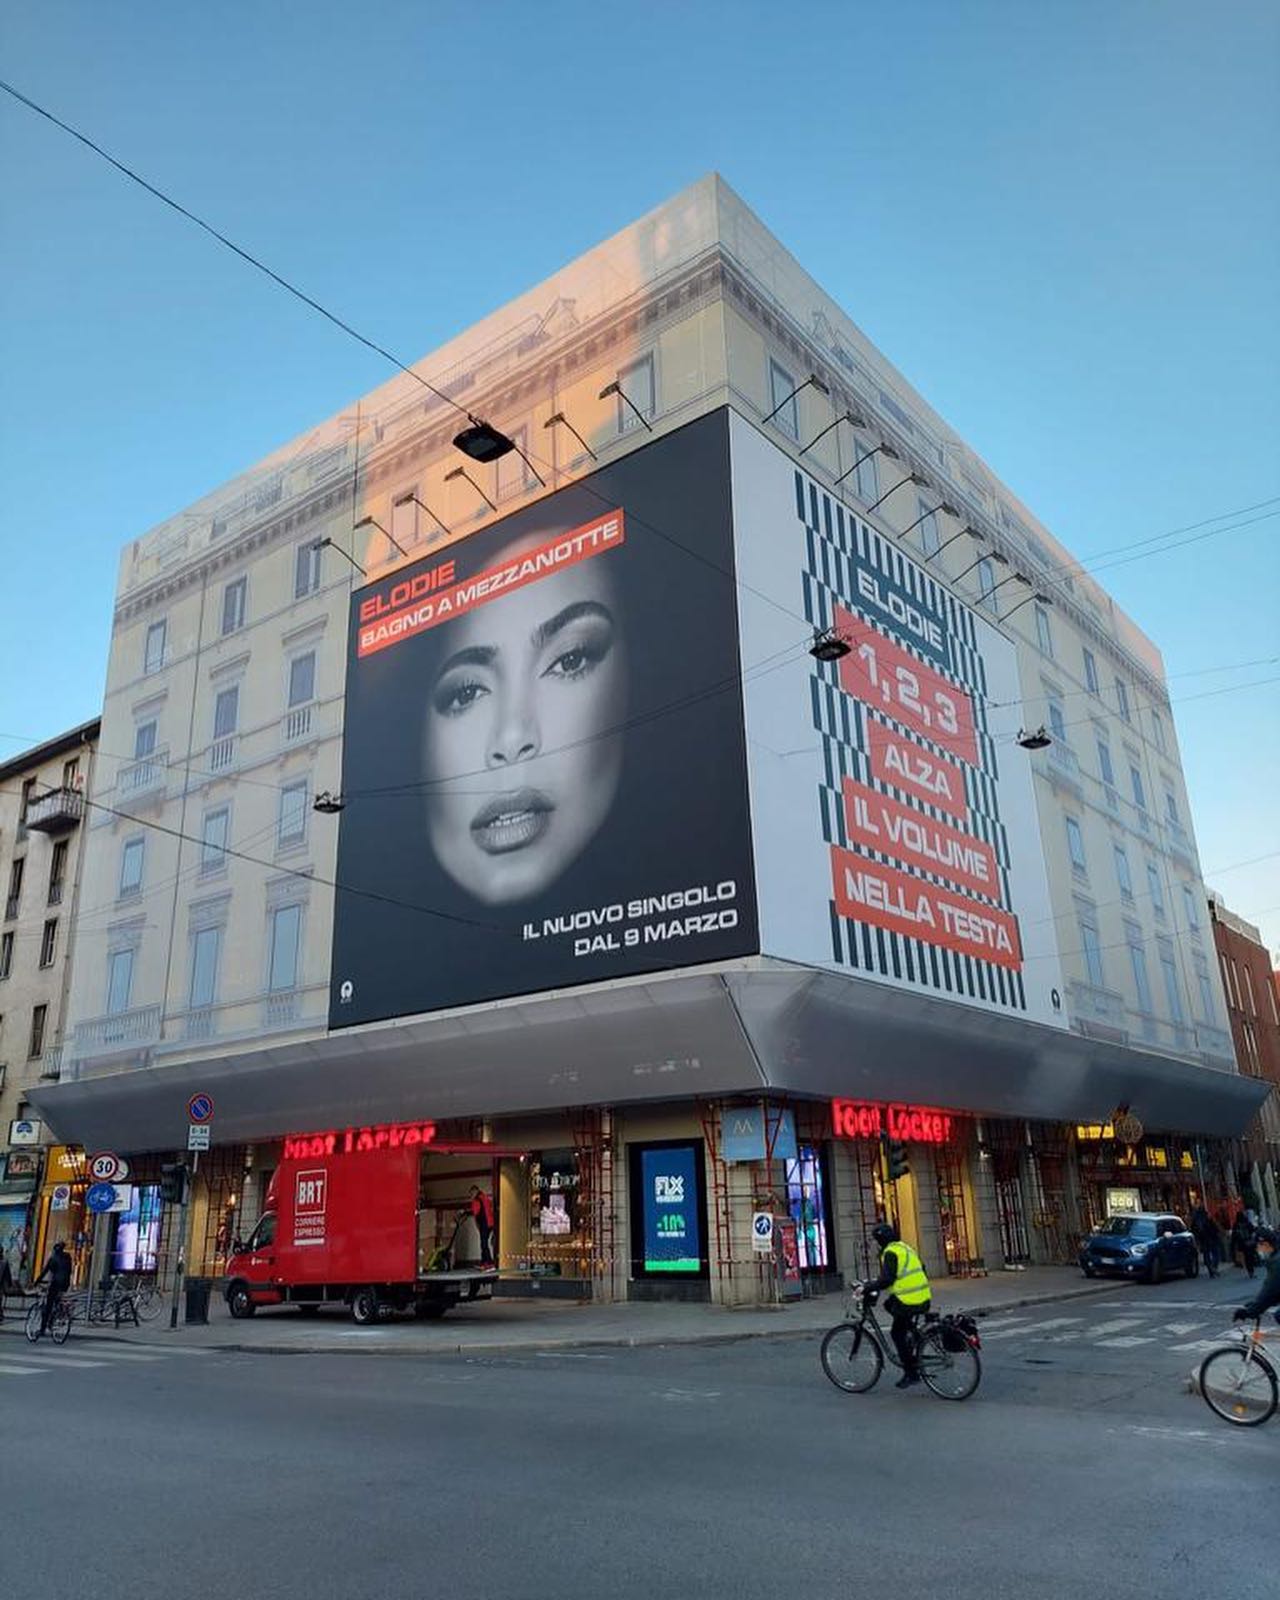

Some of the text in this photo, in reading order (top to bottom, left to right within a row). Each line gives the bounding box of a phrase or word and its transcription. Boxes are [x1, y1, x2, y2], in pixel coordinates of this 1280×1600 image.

[360, 518, 619, 649] BAGNO A MEZZANOTTE
[360, 560, 456, 622] ELODIE
[857, 568, 944, 653] ELODIE
[884, 743, 953, 801] ALZA
[854, 796, 990, 883] IL VOLUME
[523, 880, 737, 941] IL NUOVO SINGOLO
[574, 908, 739, 957] DAL 9 MARZO
[845, 867, 1014, 955] NELLA TESTA
[886, 1102, 952, 1142] Locker
[95, 1160, 113, 1174] 30
[298, 1179, 324, 1205] BRT
